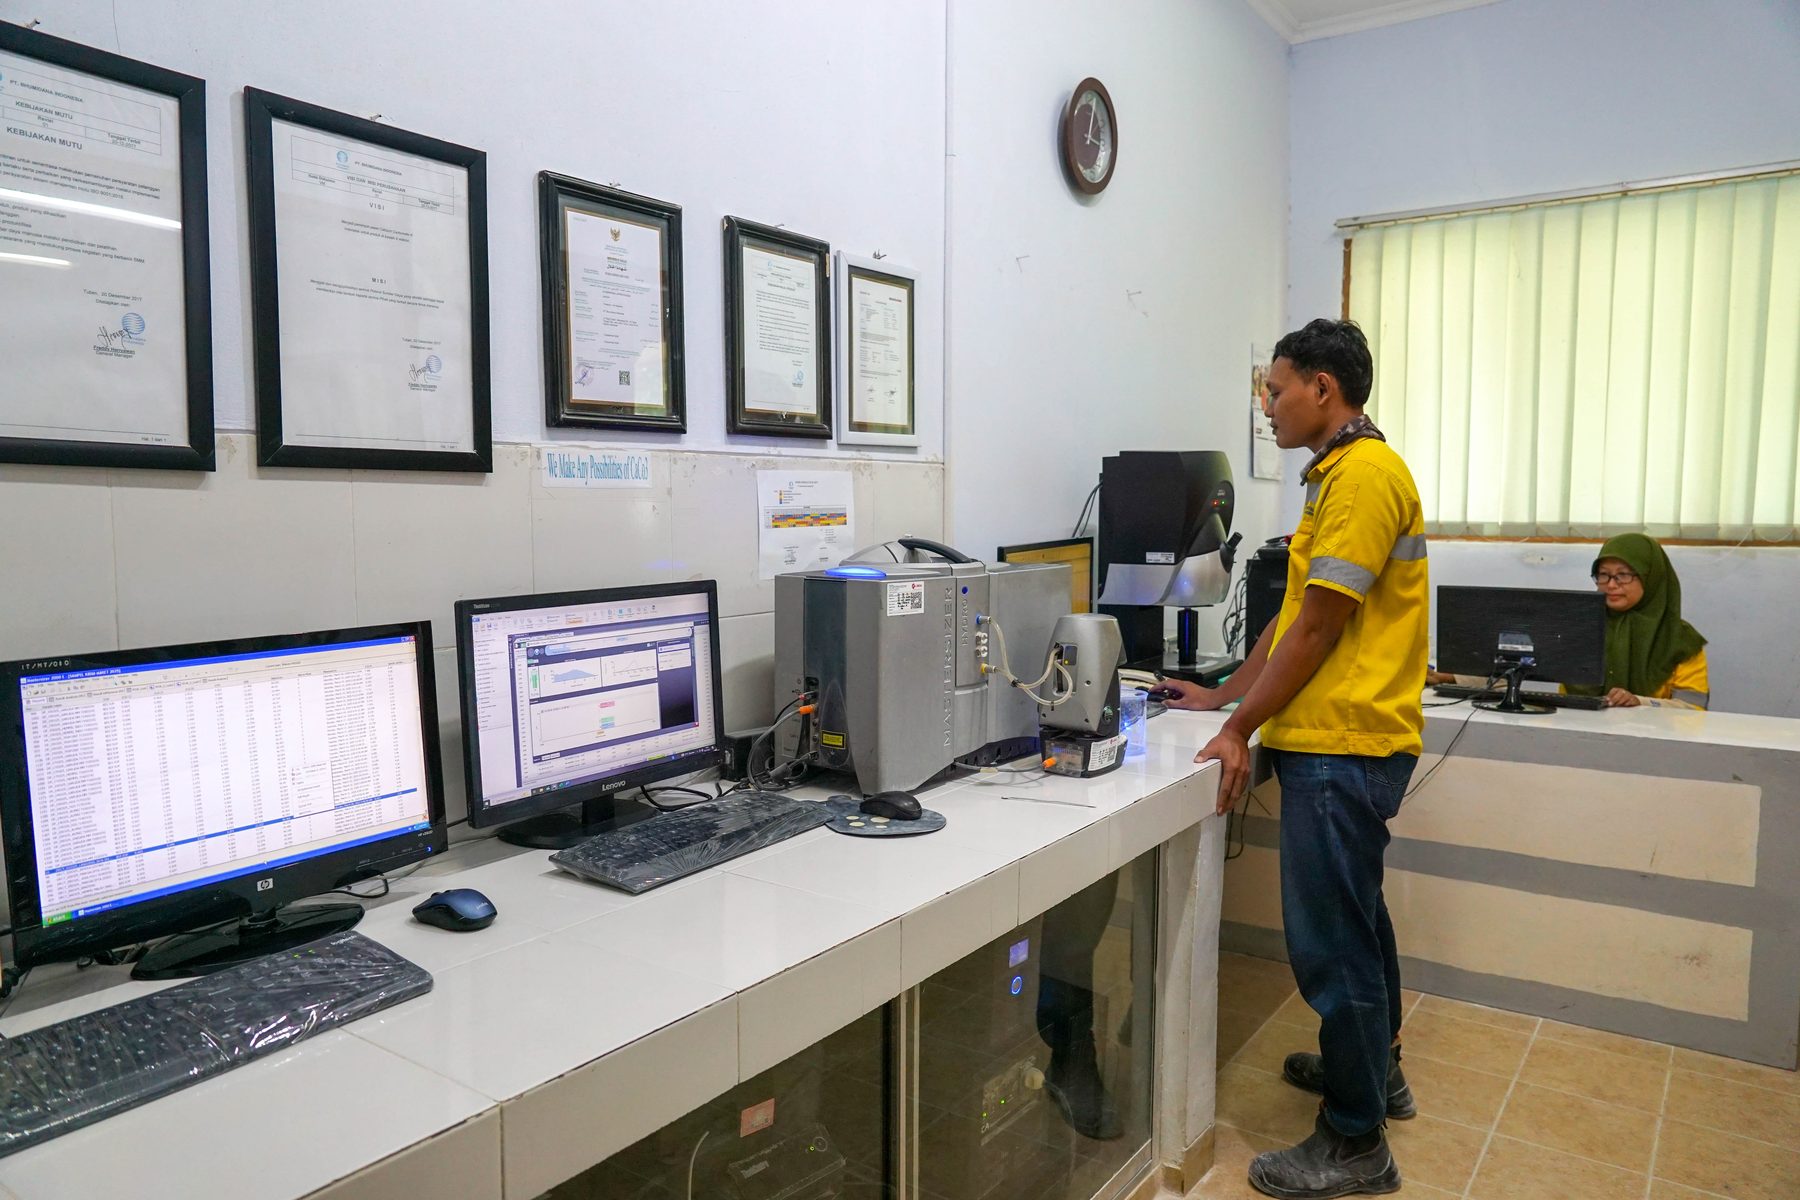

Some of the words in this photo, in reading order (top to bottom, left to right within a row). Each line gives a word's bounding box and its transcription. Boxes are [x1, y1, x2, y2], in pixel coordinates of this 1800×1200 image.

[15, 100, 53, 115] KEBIJAKAN
[54, 110, 73, 120] MUTU
[6, 126, 57, 143] KEBIJAKAN
[59, 138, 83, 150] MUTU
[547, 452, 558, 479] We
[558, 453, 576, 479] Make
[961, 598, 970, 647] HYDRO
[943, 586, 953, 747] MASTERSIZER
[601, 780, 627, 792] Lenovo
